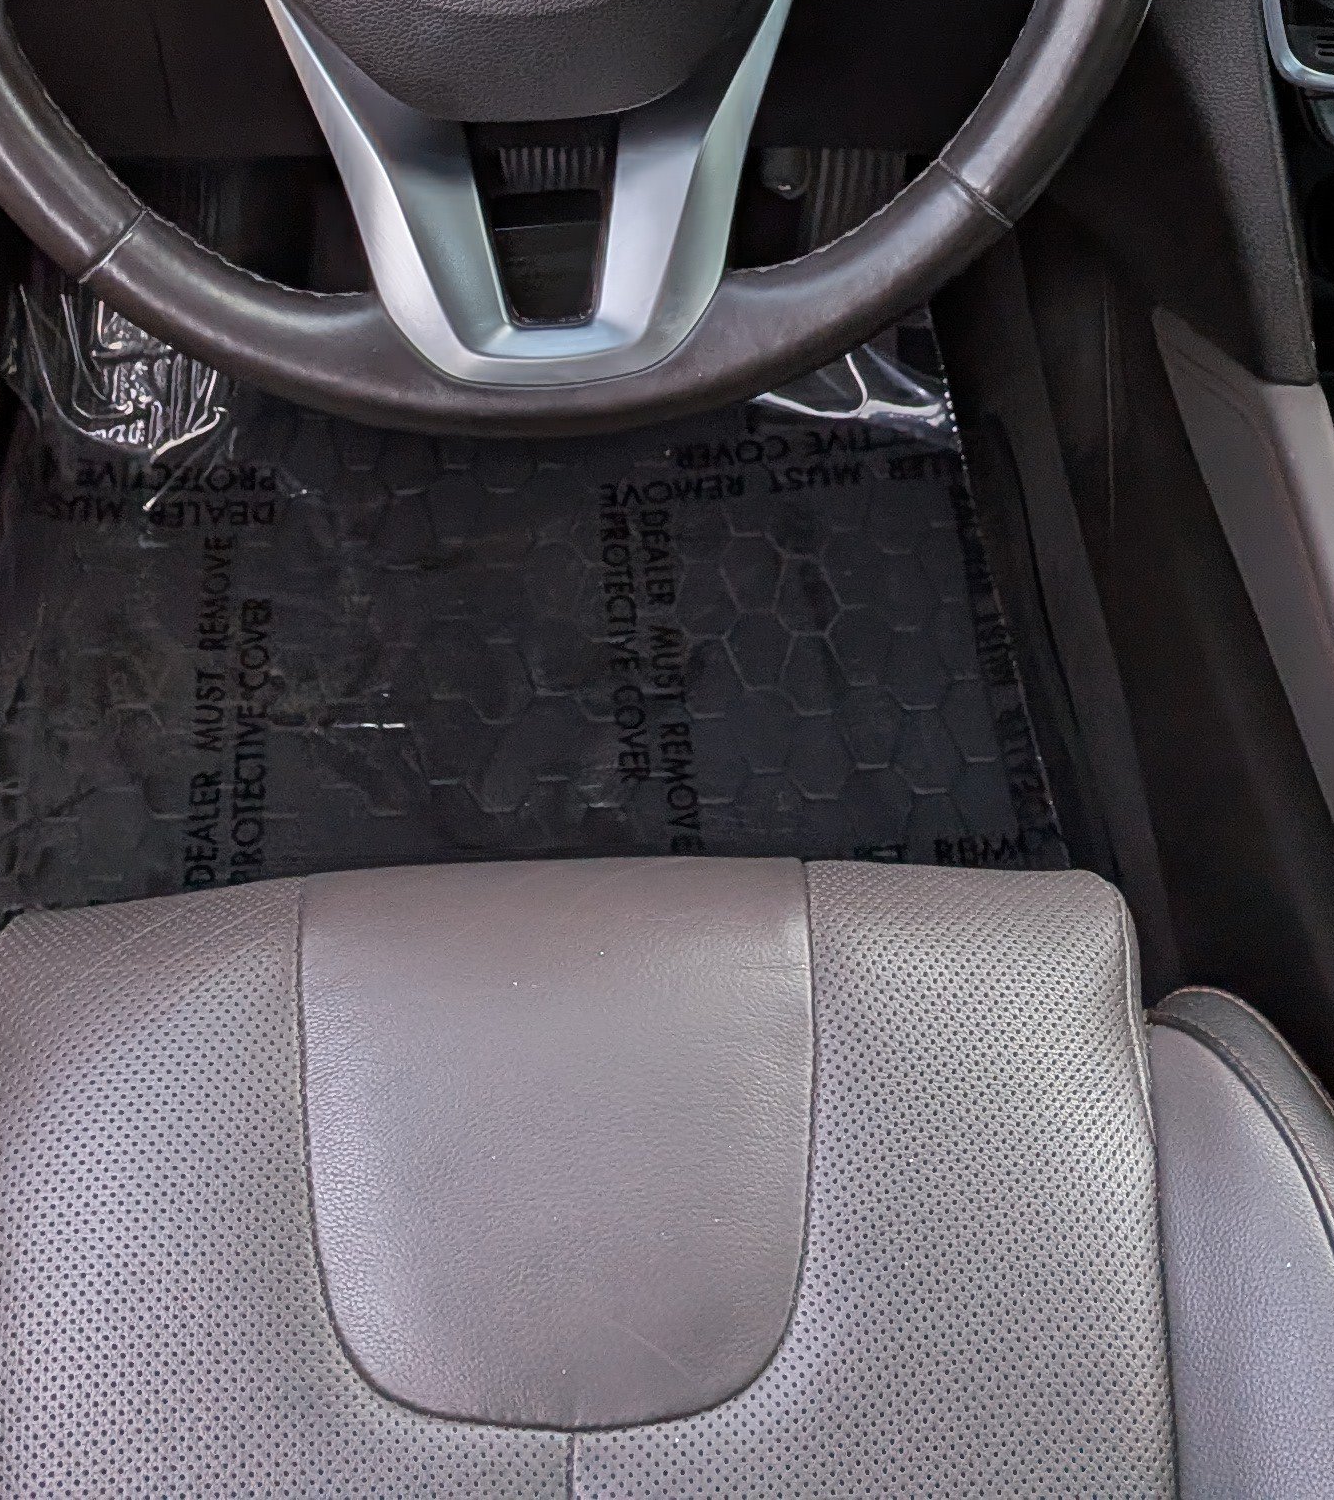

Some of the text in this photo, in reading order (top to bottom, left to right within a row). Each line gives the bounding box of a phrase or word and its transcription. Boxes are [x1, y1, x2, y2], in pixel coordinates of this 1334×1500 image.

[640, 507, 677, 607] DEALER
[183, 534, 234, 888] DEALER MUST REMOVE
[612, 685, 652, 785] COVER
